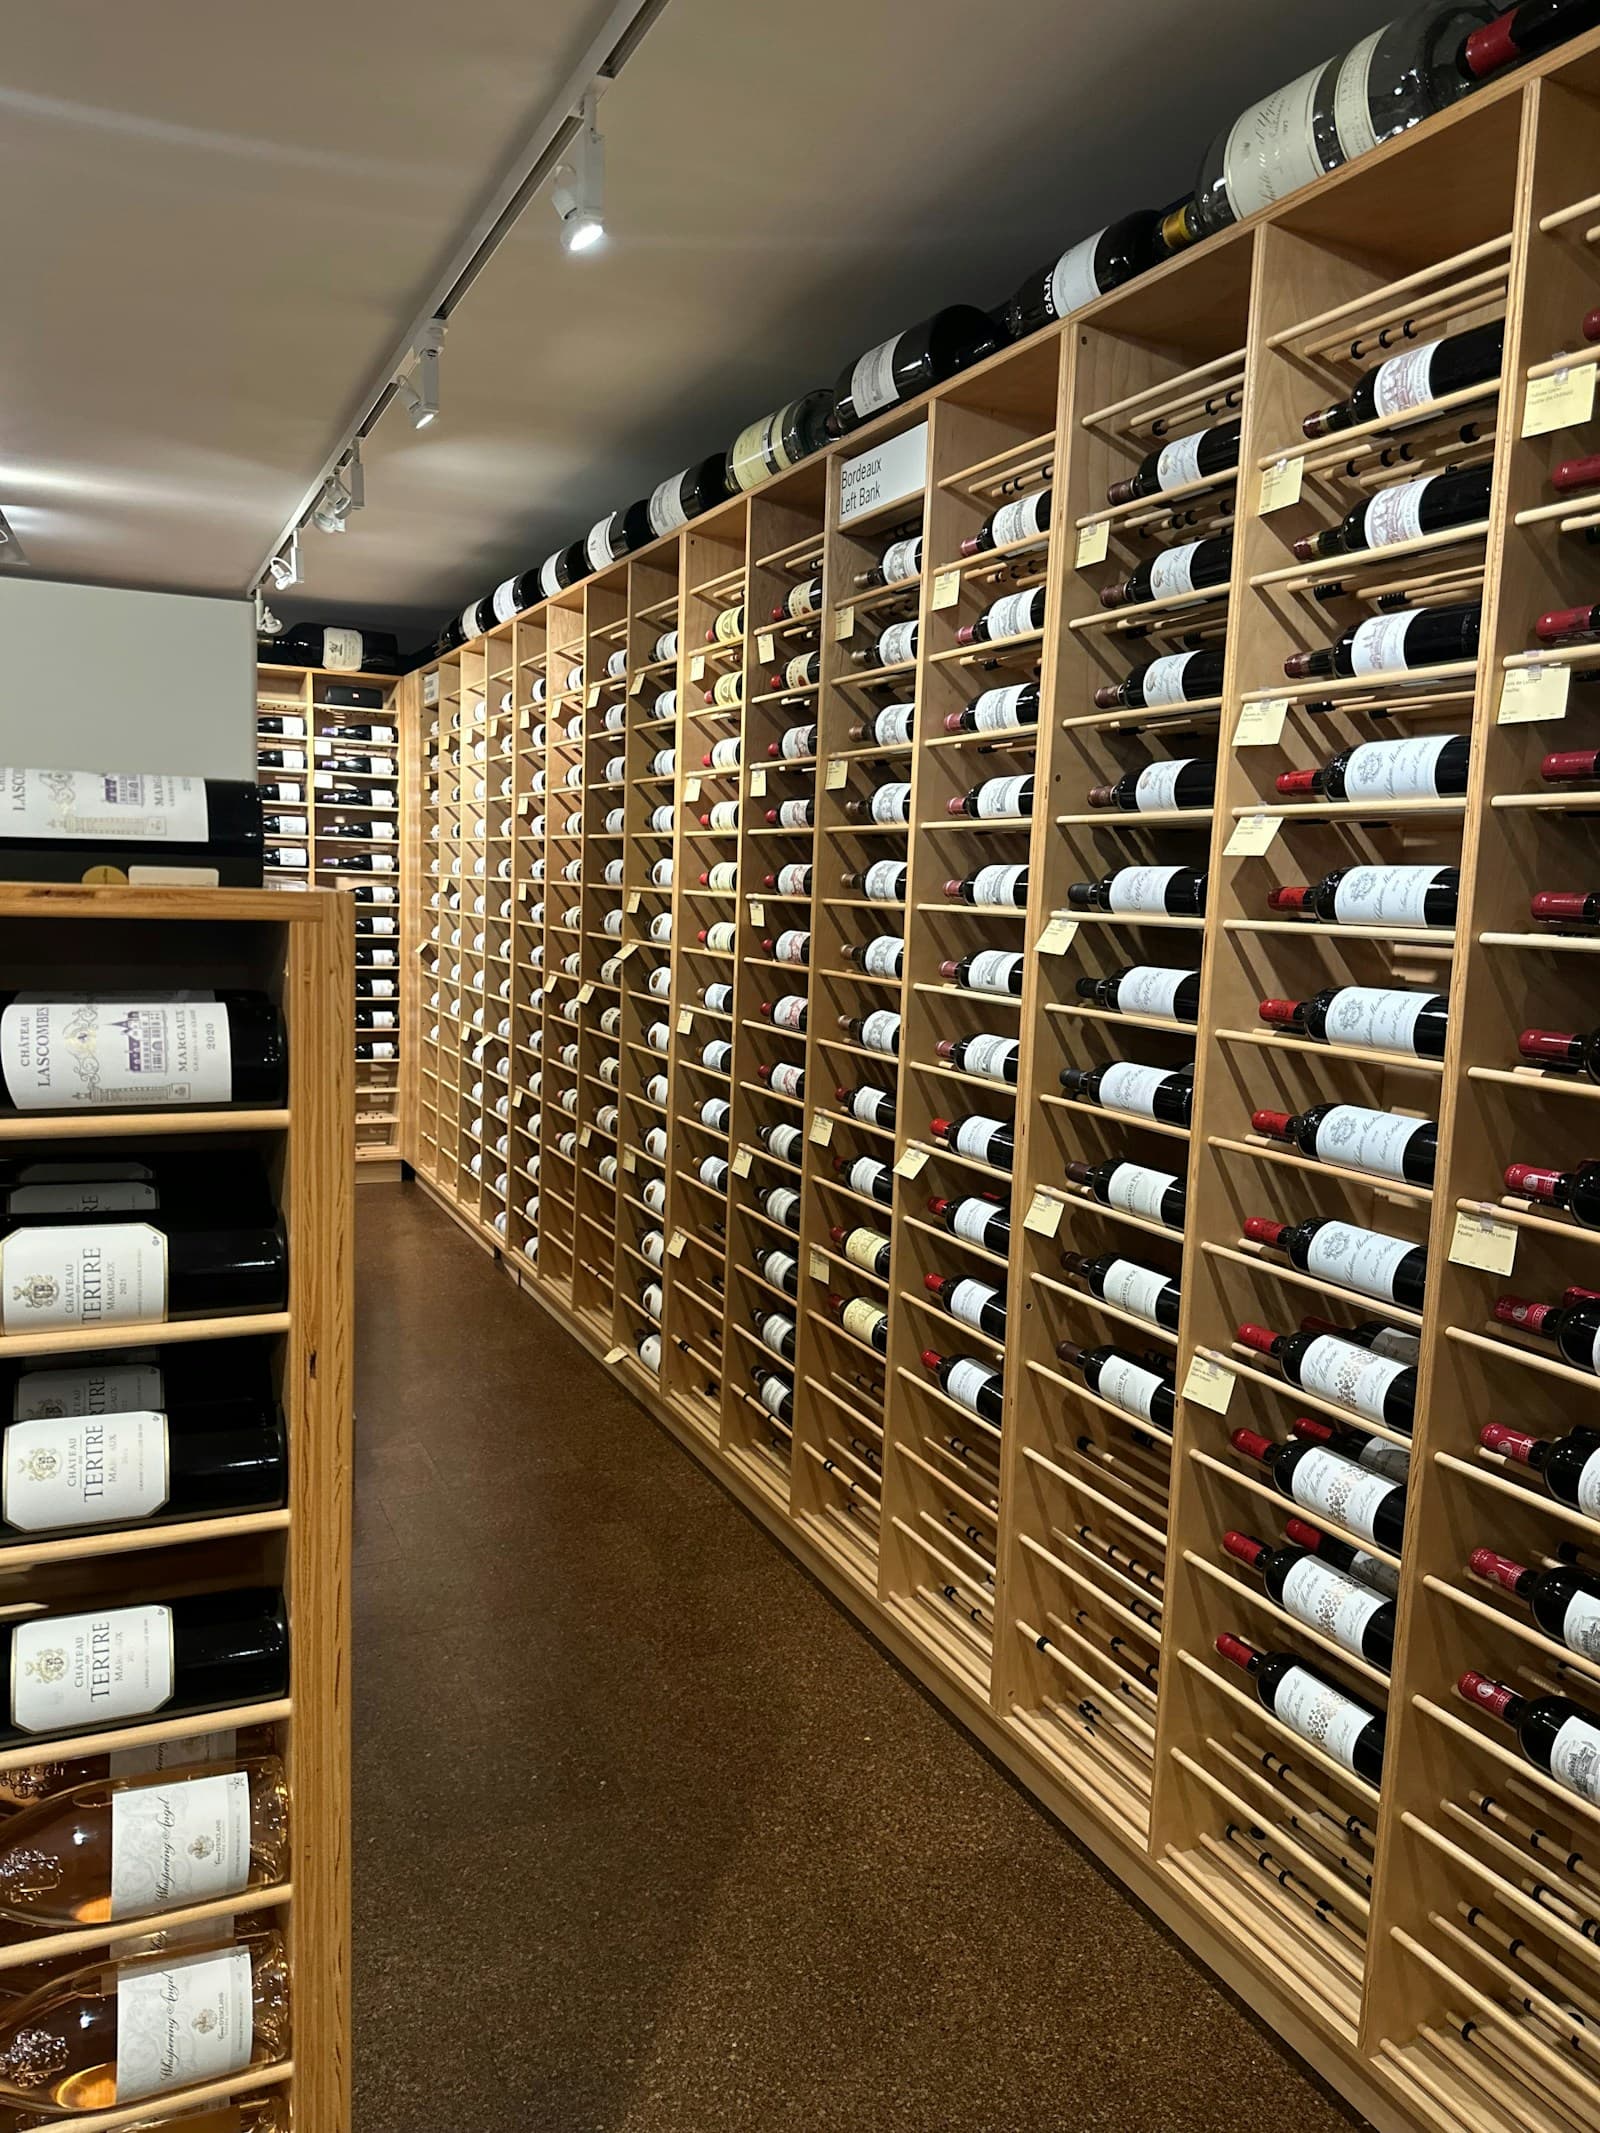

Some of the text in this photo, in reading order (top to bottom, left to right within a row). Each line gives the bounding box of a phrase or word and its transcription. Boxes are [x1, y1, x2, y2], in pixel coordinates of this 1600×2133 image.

[841, 457, 882, 490] Bordeaux
[841, 480, 880, 515] Left Bank
[20, 1016, 31, 1067] CHÂTEAU
[36, 1007, 51, 1088] LASCOMBES
[175, 1009, 188, 1072] MARGAUX
[206, 1023, 216, 1050] 2020
[65, 1263, 74, 1314] CHÂTEAU
[82, 1247, 102, 1324] TERTRE
[106, 1261, 115, 1310] MARGAUX
[84, 1425, 104, 1502] TERTRE
[91, 1621, 110, 1702] TERTRE
[156, 1797, 177, 1902] Whispering Angel
[160, 1971, 181, 2082] Whispering Angel
